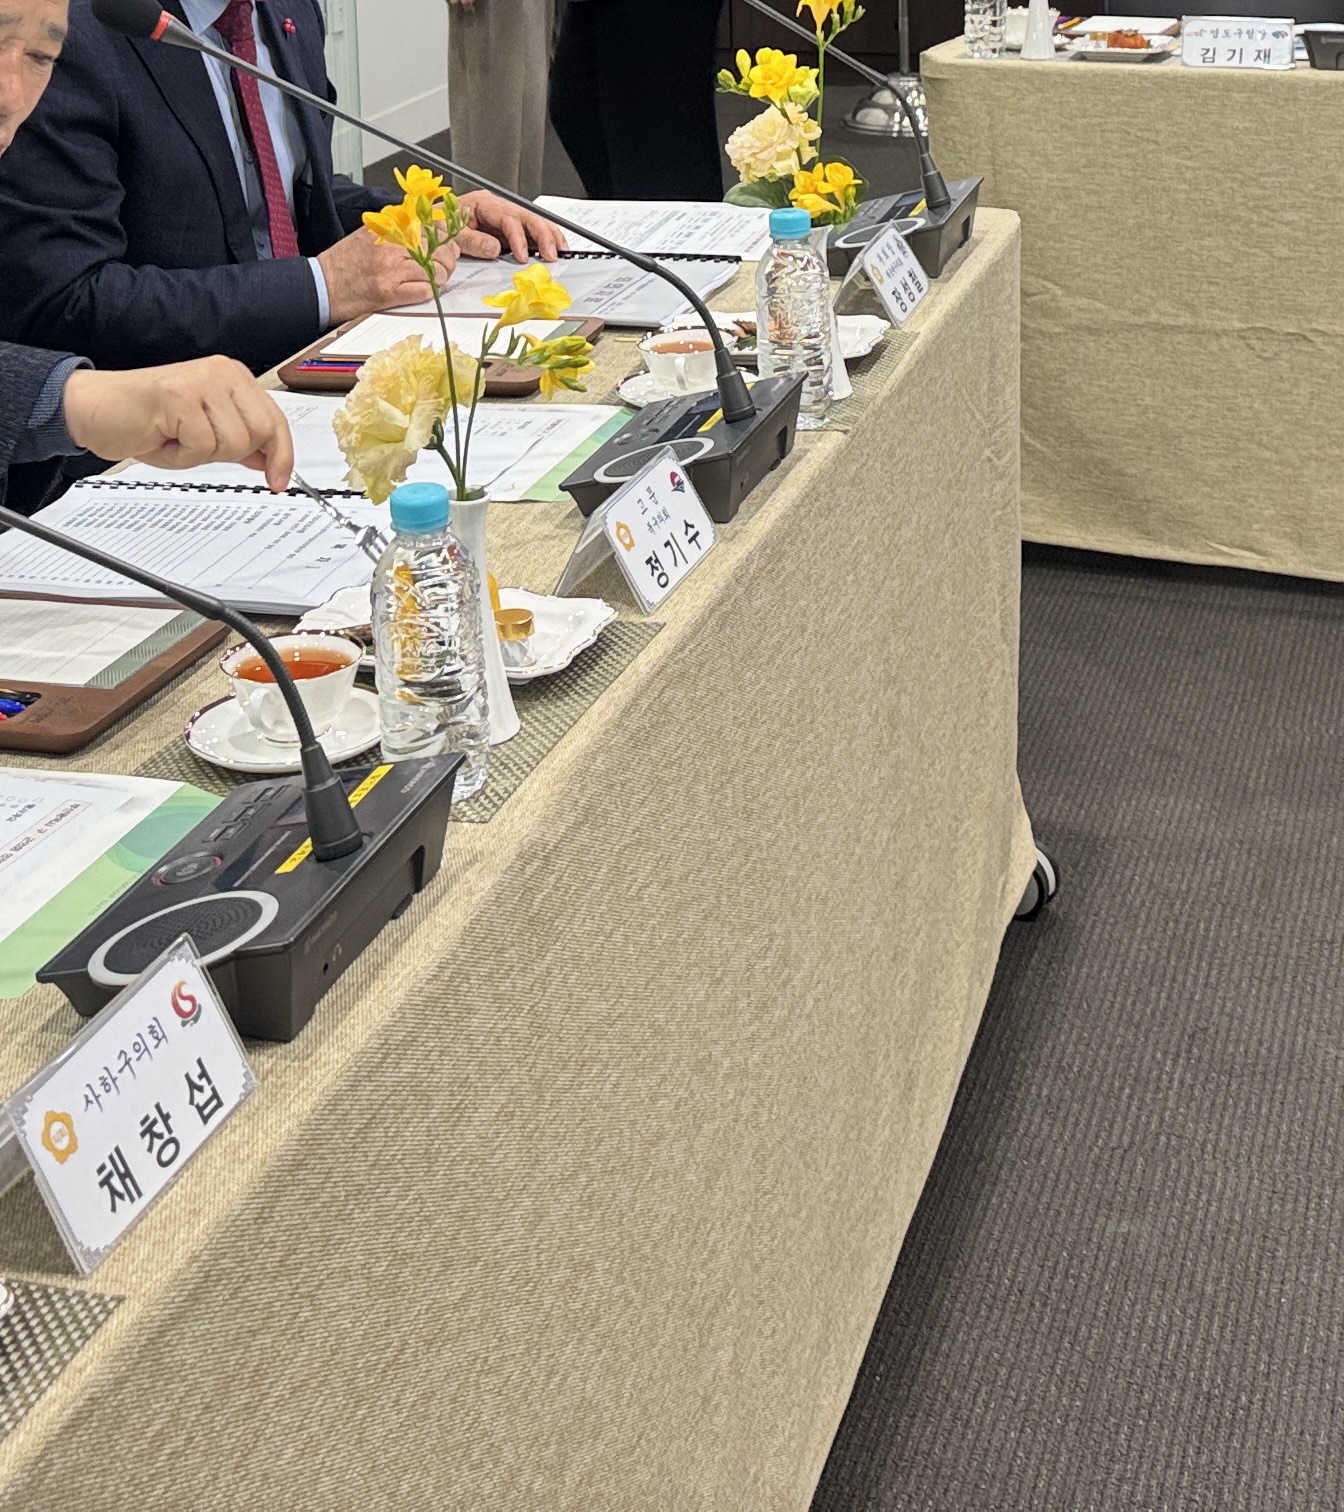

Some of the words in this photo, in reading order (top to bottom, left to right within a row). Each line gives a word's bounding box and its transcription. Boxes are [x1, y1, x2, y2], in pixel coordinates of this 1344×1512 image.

[1200, 47, 1272, 64] 김기재
[645, 519, 702, 589] 정기수
[82, 1017, 169, 1113] 사하구의회
[94, 1057, 225, 1213] 채창섭
